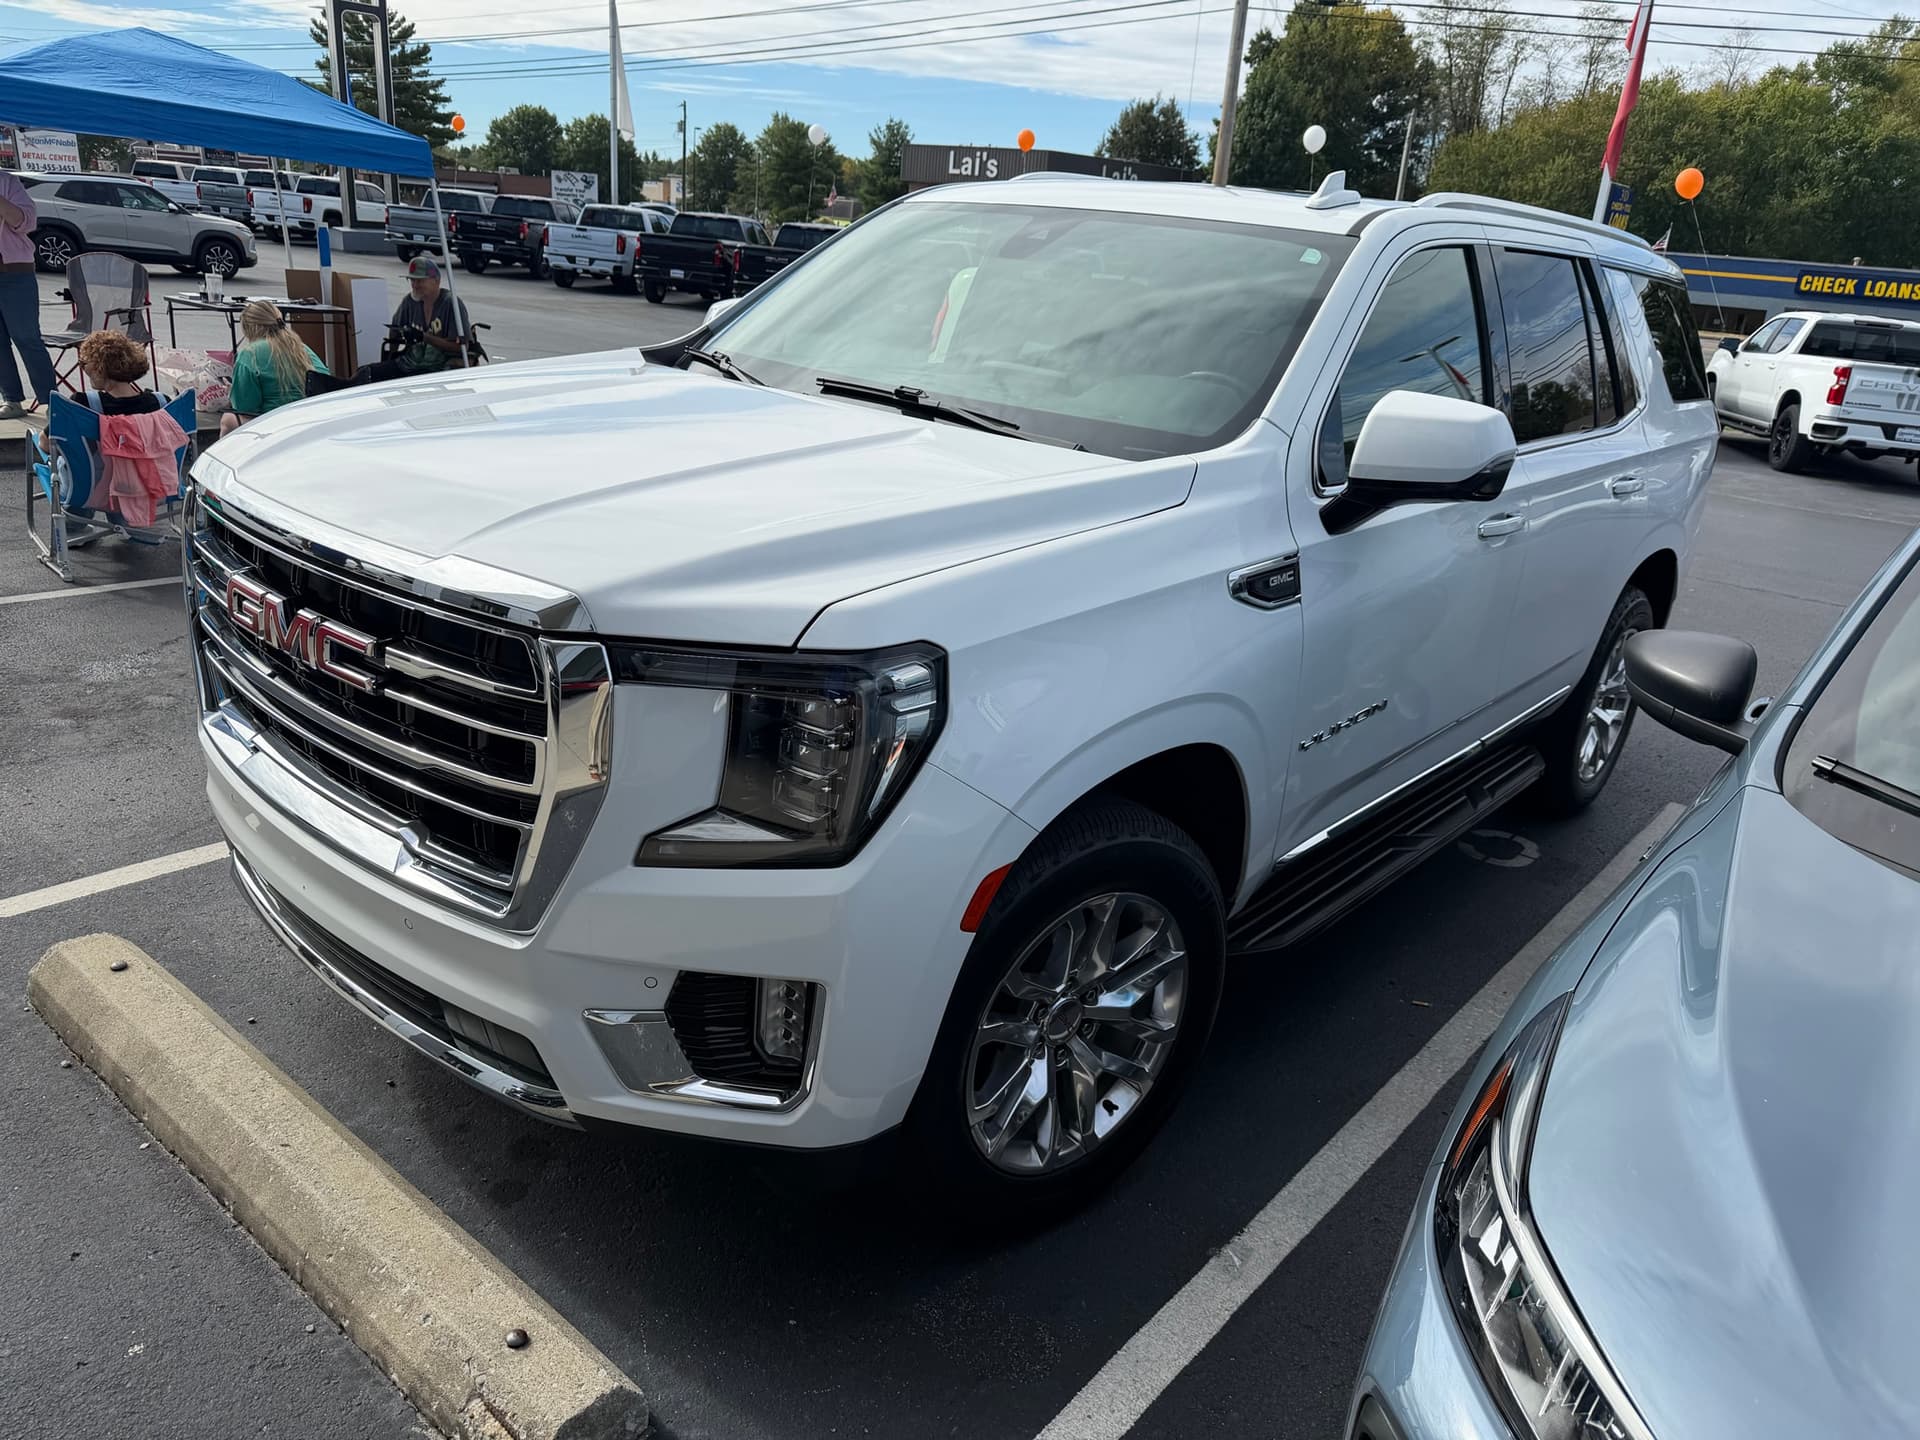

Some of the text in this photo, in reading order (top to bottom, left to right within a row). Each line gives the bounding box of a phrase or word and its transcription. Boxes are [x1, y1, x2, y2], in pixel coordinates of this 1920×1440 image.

[22, 152, 77, 162] DETAIL CENTER
[949, 150, 998, 178] Lai's
[1799, 275, 1920, 301] CHECK LOANS
[1269, 570, 1295, 587] GMC
[226, 574, 377, 696] GMC
[1298, 698, 1388, 752] YUKON
